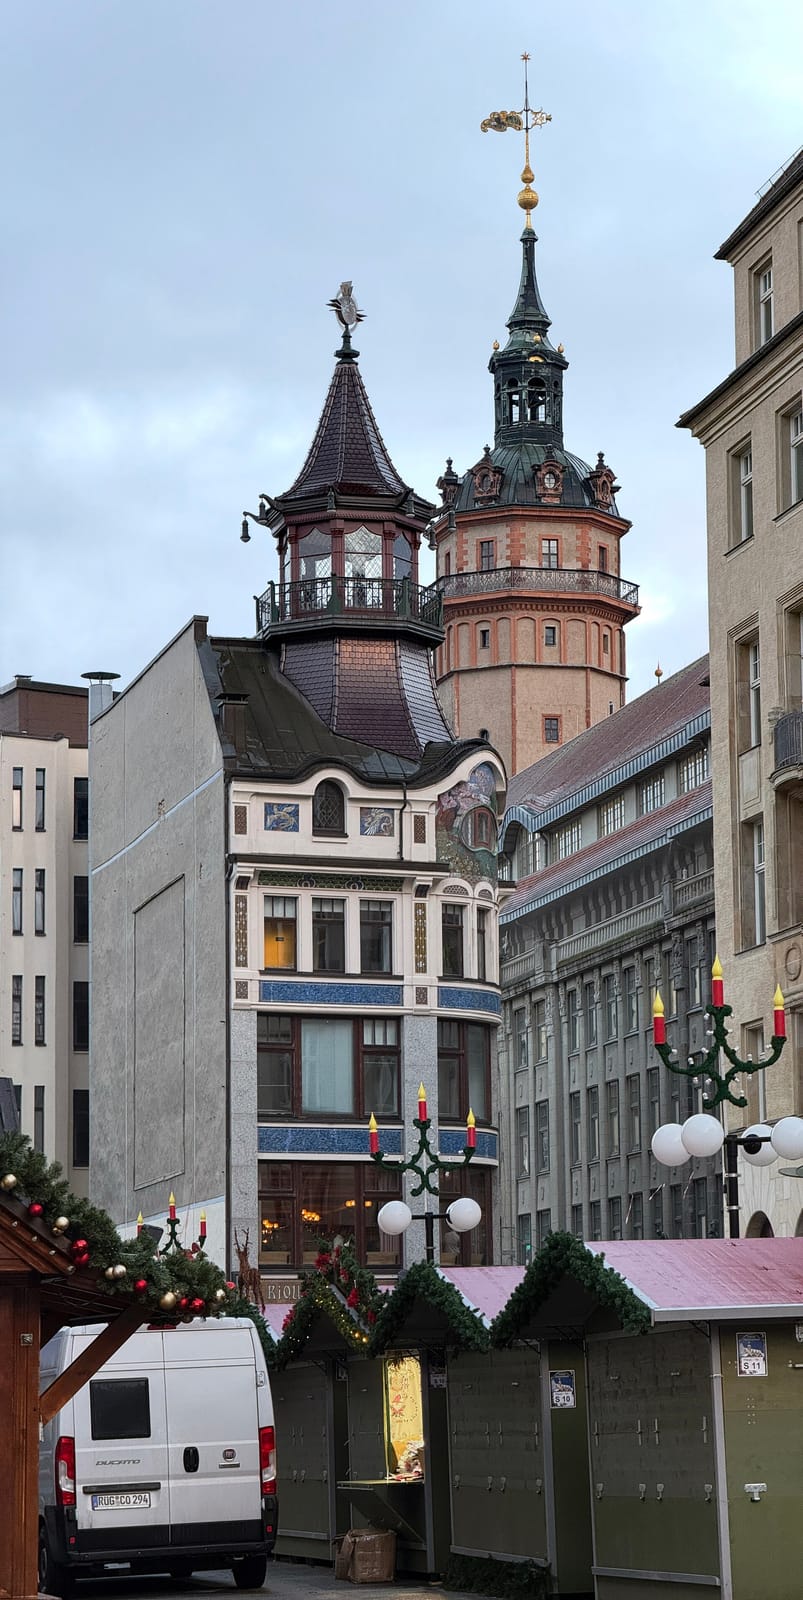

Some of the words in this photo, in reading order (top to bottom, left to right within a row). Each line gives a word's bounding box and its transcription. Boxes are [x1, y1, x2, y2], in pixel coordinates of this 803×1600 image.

[743, 1362, 750, 1370] S
[752, 1362, 760, 1370] 11
[98, 1496, 115, 1505] RÜG
[120, 1495, 131, 1504] CO
[132, 1495, 148, 1504] 294
